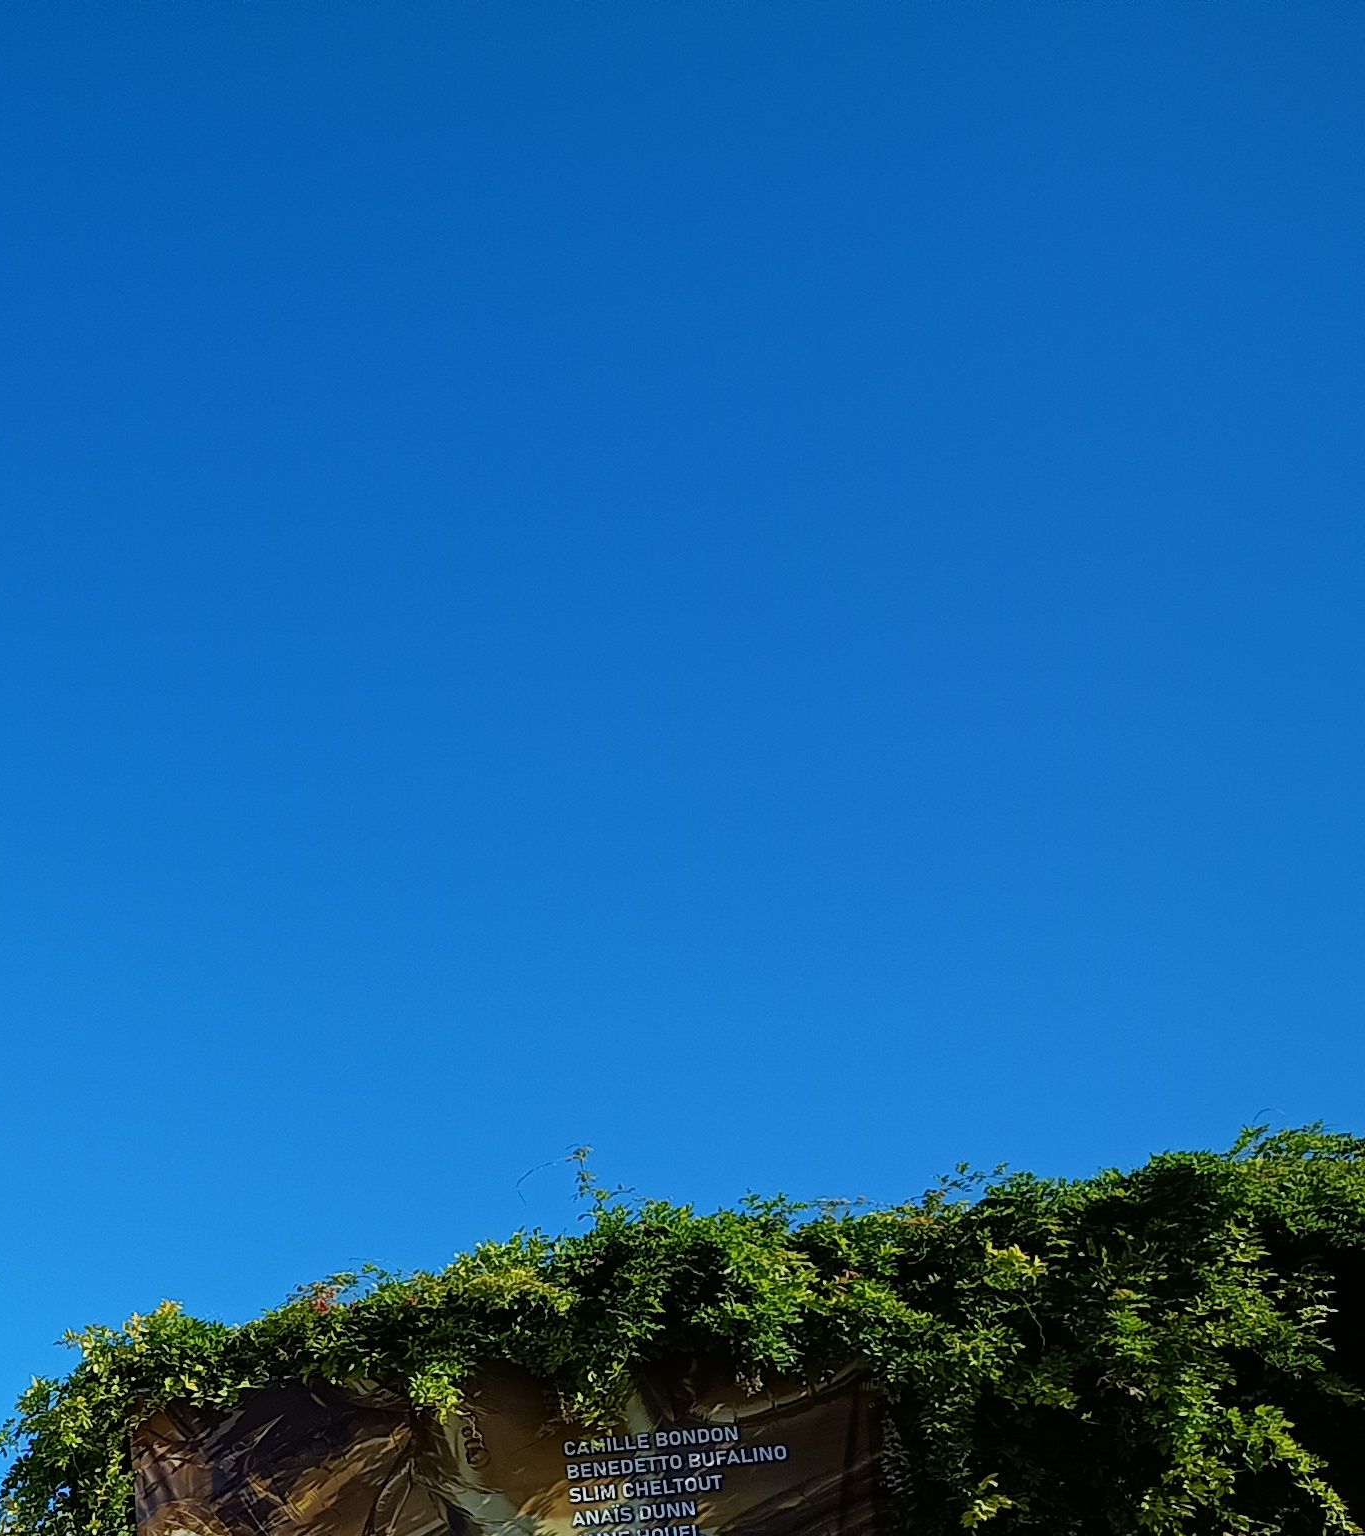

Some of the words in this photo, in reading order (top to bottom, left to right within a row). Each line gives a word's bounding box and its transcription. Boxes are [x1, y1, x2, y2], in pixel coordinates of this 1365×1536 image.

[563, 1433, 649, 1456] CAMILLE
[655, 1425, 739, 1448] BONDON
[566, 1454, 682, 1479] BENEDETTO
[688, 1445, 787, 1469] BUFALINO
[569, 1484, 616, 1503] SLIM
[622, 1474, 722, 1498] CHELTOUT
[572, 1504, 632, 1527] ANAÏS
[639, 1501, 696, 1520] DUNN
